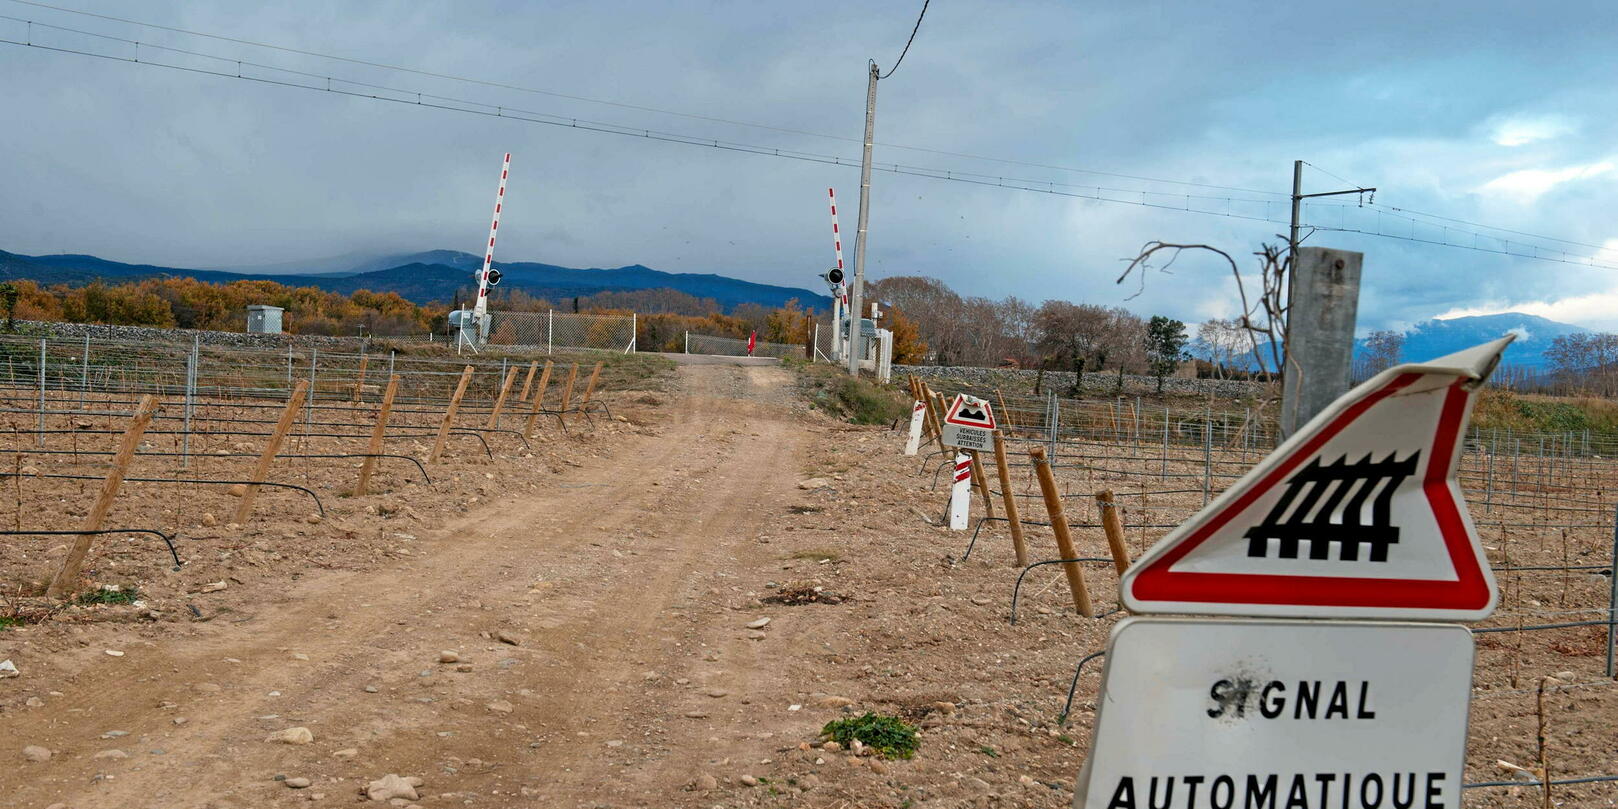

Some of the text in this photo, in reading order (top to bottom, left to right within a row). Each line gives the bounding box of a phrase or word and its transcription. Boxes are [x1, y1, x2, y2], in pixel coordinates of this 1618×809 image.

[957, 440, 983, 448] ATTENTION
[1206, 679, 1376, 720] SIGNAL
[1106, 773, 1446, 809] AUTOMATIQUE
